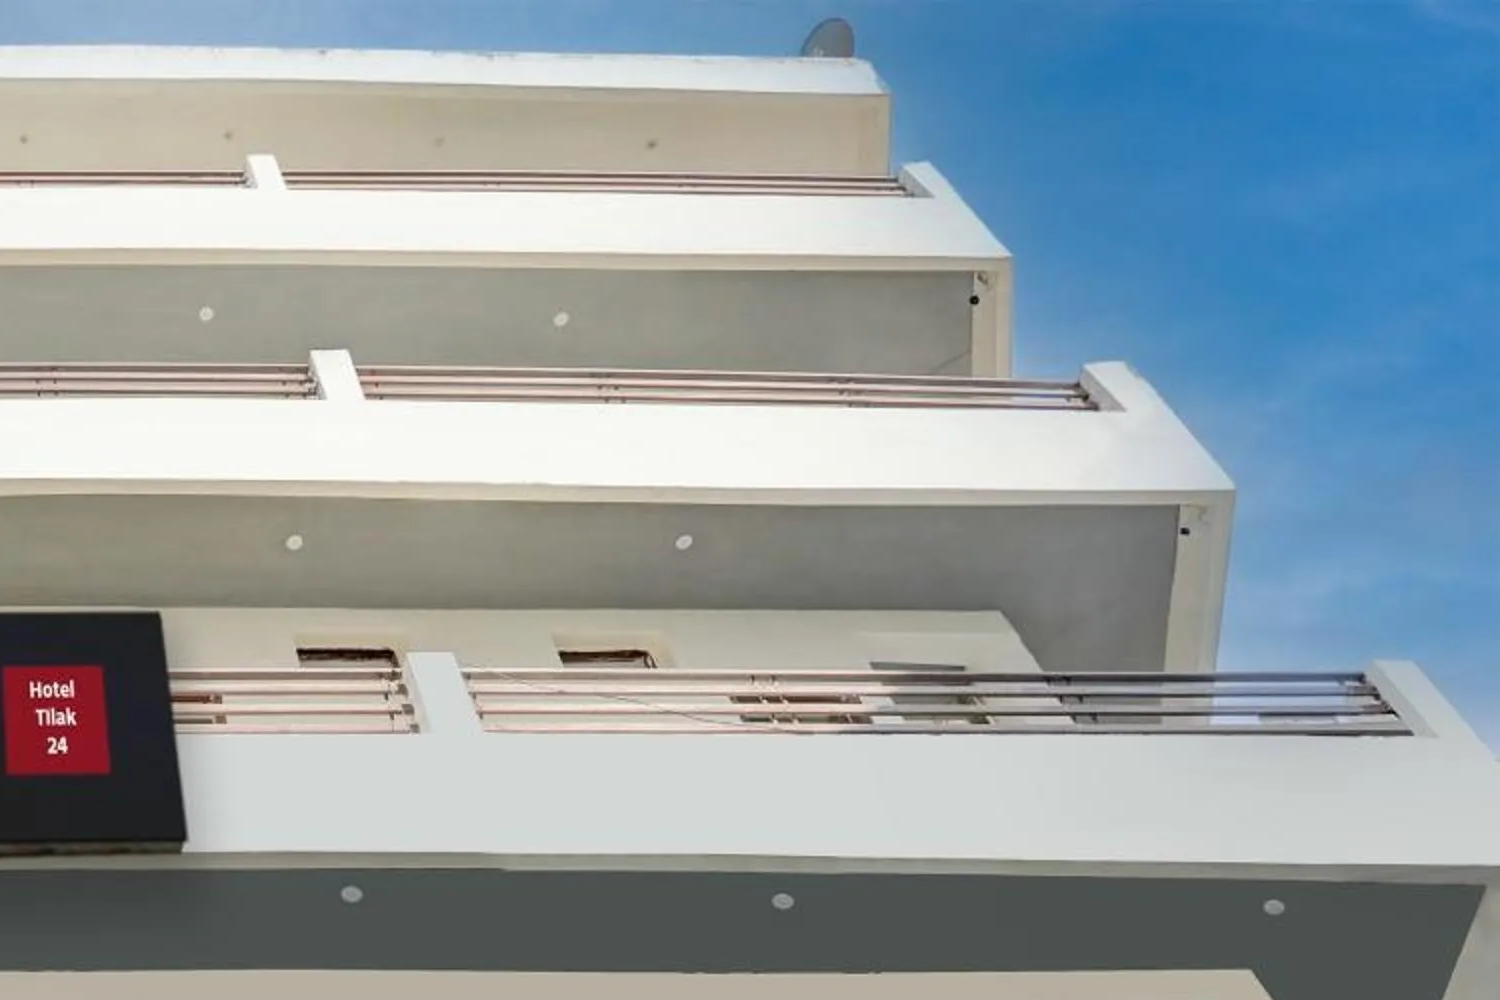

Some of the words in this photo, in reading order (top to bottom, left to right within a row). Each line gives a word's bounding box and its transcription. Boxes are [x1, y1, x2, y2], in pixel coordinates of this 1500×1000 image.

[28, 680, 76, 699] Hotel
[35, 707, 77, 727] Tilak
[46, 736, 69, 755] 24
